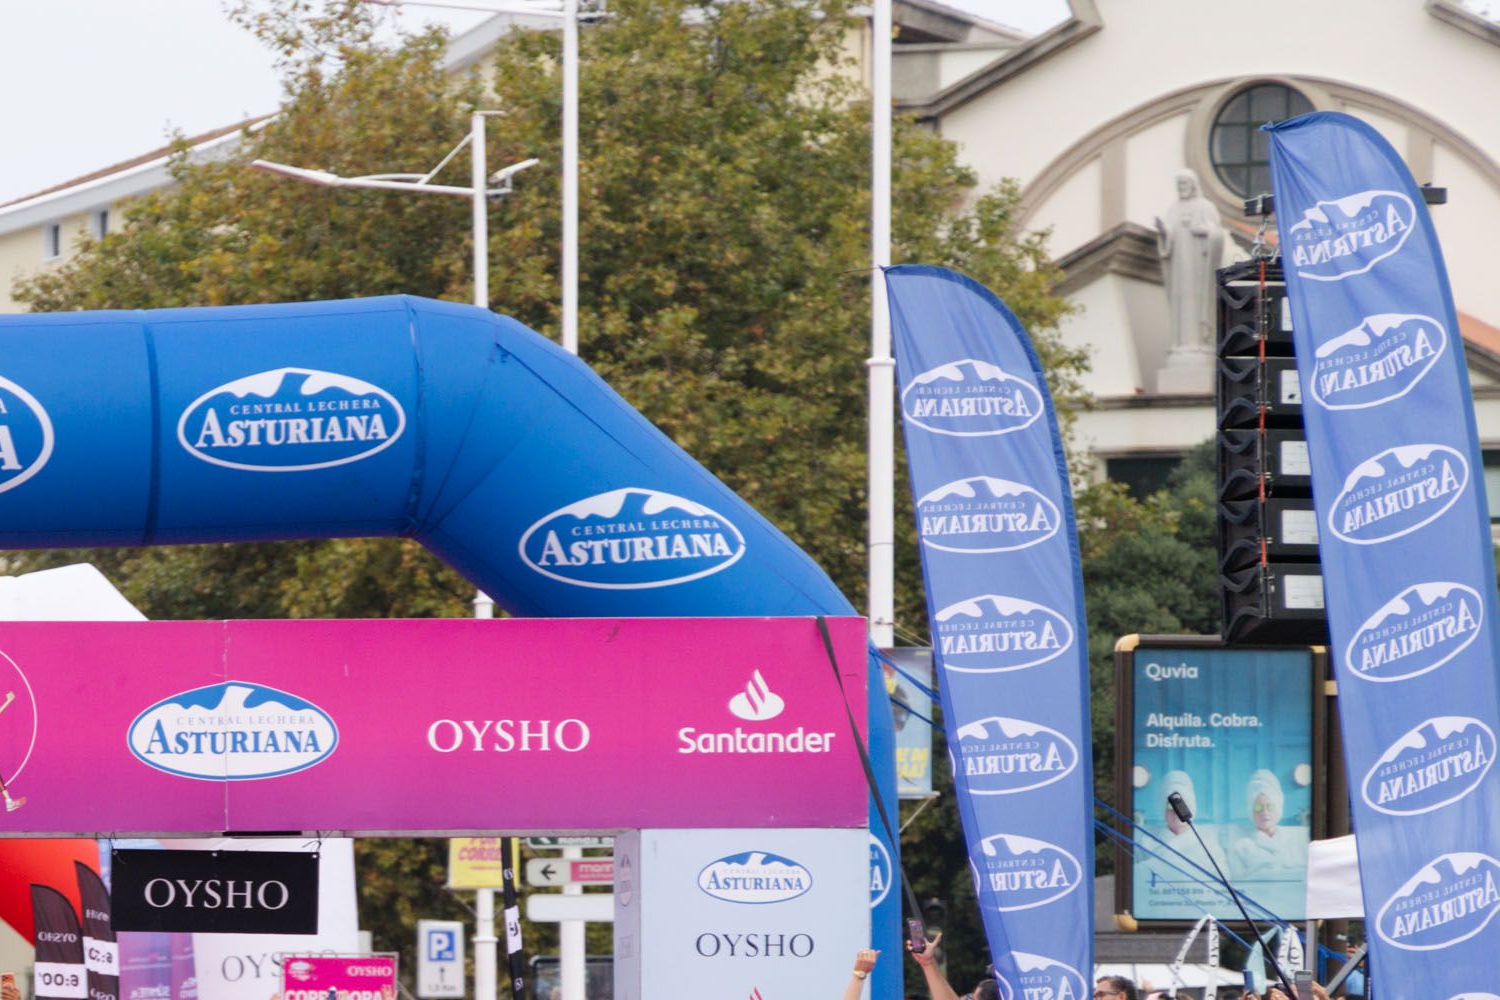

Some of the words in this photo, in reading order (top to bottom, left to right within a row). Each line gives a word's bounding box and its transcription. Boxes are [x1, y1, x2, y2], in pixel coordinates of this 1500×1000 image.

[230, 402, 302, 415] CENTRAL
[308, 398, 381, 412] LECHERA
[194, 407, 389, 448] ASTURIANA
[571, 521, 646, 537] CENTRAL
[652, 518, 720, 531] LECHERA
[537, 529, 734, 567] ASTURIANA
[1145, 663, 1199, 681] Quvia
[176, 715, 243, 726] CENTRAL
[249, 715, 315, 725] LECHERA
[1146, 712, 1207, 730] Alquila.
[1209, 712, 1263, 728] Cobra.
[144, 718, 322, 755] ASTURIANA
[427, 718, 591, 753] OYSHO
[677, 726, 836, 754] Santander
[1146, 733, 1215, 748] Disfruta.
[706, 870, 804, 890] ASTURIANA
[144, 877, 290, 911] OYSHO
[695, 933, 815, 957] OYSHO
